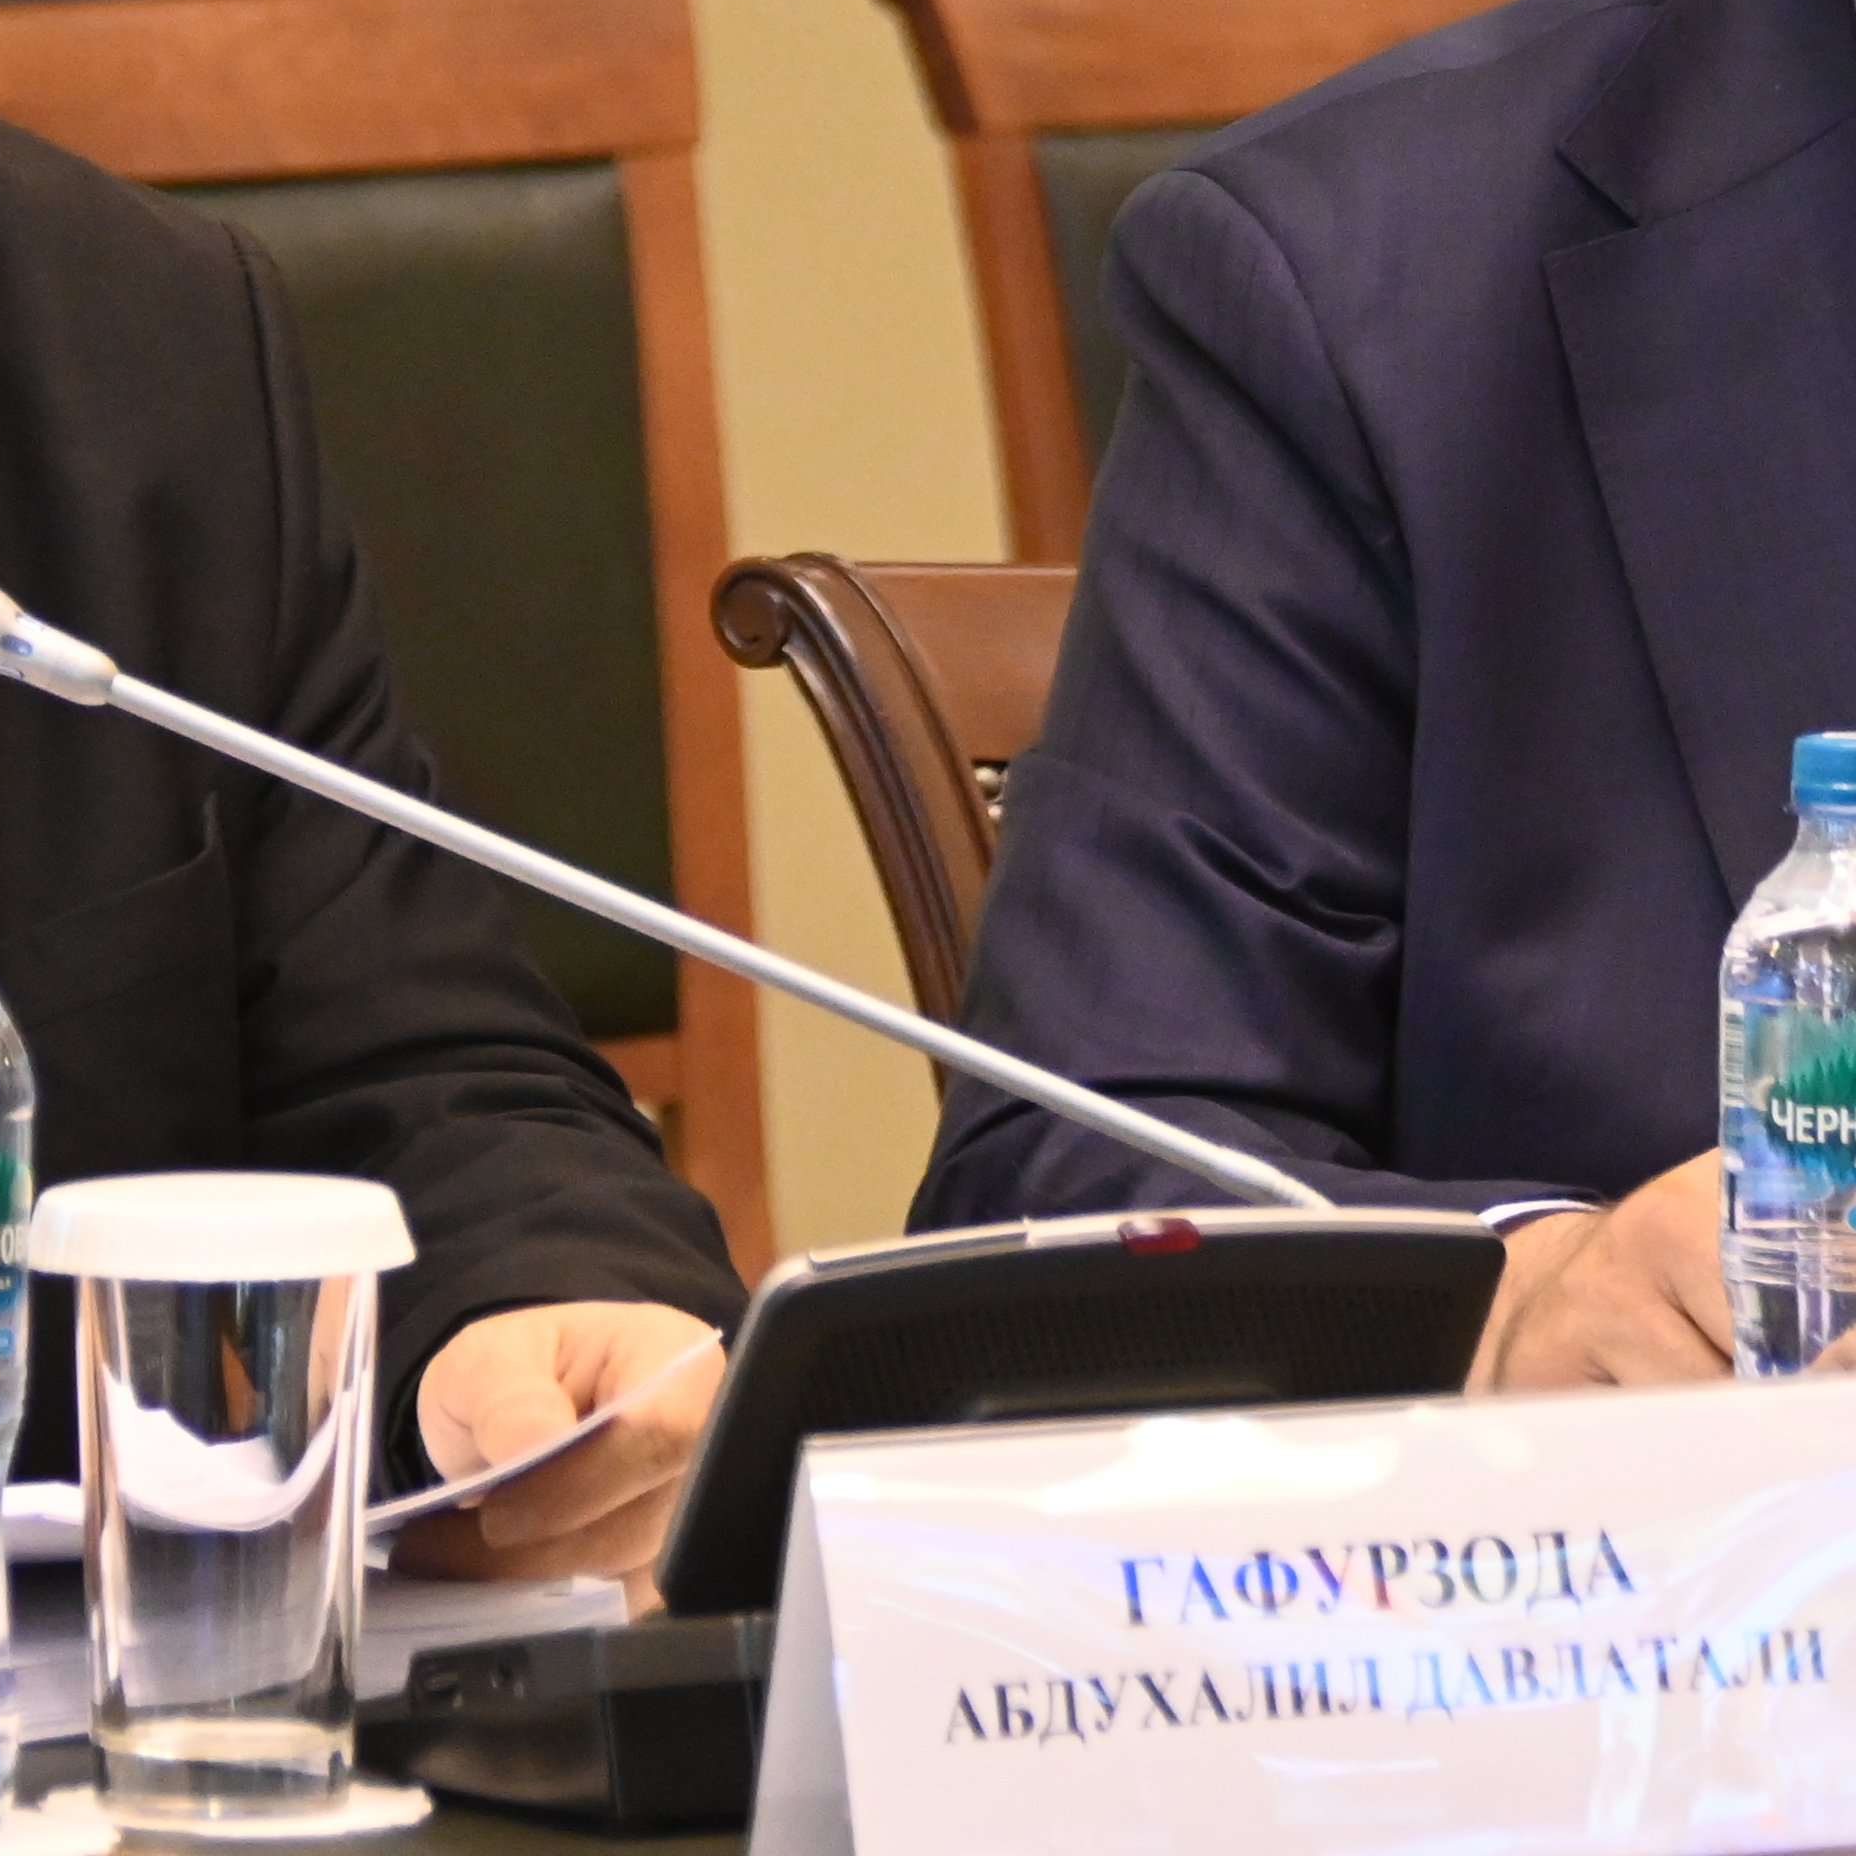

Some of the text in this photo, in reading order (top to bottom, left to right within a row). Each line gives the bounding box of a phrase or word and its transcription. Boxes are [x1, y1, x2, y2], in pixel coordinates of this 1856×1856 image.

[1118, 1526, 1635, 1628] ГАФУРЗОДА
[943, 1625, 1828, 1748] АБДУХАЛИЛ ДАВЛАТАЛИ
